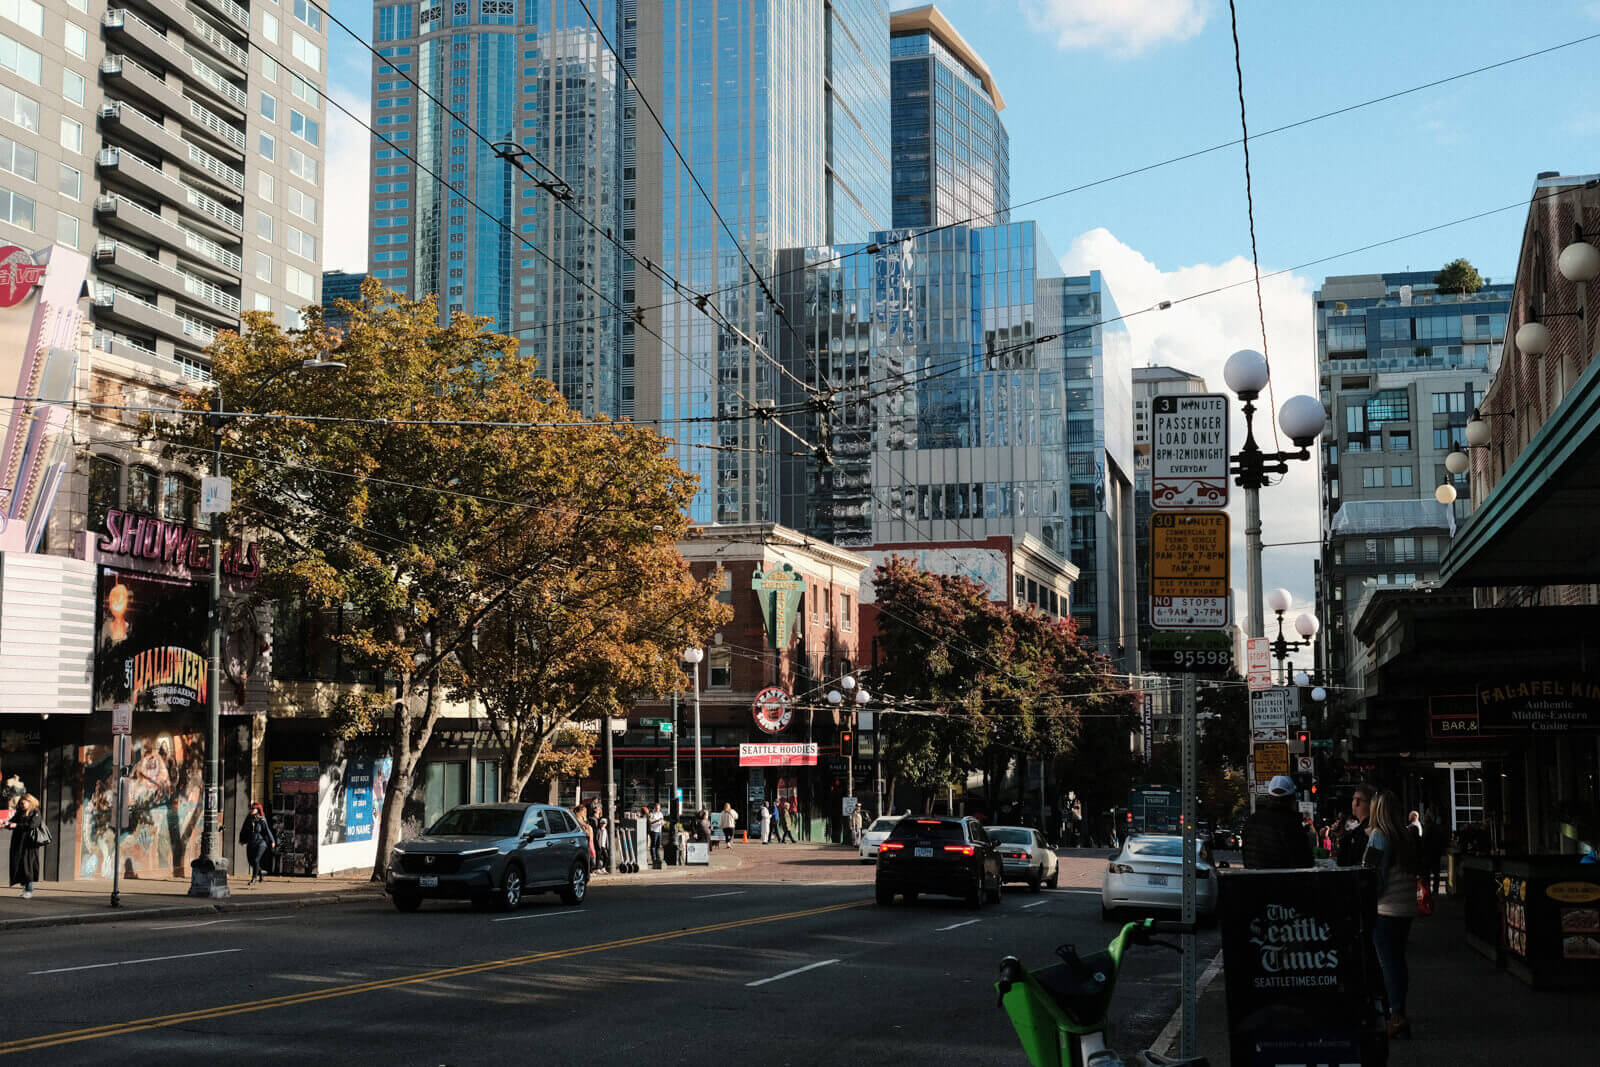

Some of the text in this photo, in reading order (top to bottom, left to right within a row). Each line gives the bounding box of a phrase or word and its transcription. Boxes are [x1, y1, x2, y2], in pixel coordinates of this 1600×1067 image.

[1161, 400, 1170, 411] 3
[1159, 416, 1221, 430] PASSENGER
[1159, 432, 1220, 445] LOAD ONLY
[1170, 465, 1207, 473] EVERYDAY
[99, 509, 260, 578] SHOWGLS
[1155, 597, 1216, 606] NO STOPS
[1157, 608, 1222, 616] 6-9AM 3-7PM
[1174, 651, 1228, 665] 95598
[134, 646, 208, 704] HALLOWEEN
[1481, 681, 1564, 704] FALAFEL
[1526, 700, 1574, 710] Authentic
[1512, 711, 1587, 720] Middle-Eastern
[1442, 721, 1465, 730] BAR
[1532, 721, 1568, 730] Cuisine
[742, 745, 816, 755] SEATTLE HOODIES
[347, 824, 371, 836] NO NAME
[1266, 904, 1297, 921] The
[1249, 917, 1332, 946] Seattle
[1259, 945, 1339, 972] Times
[1254, 975, 1337, 988] SEATTLETIMES.COM
